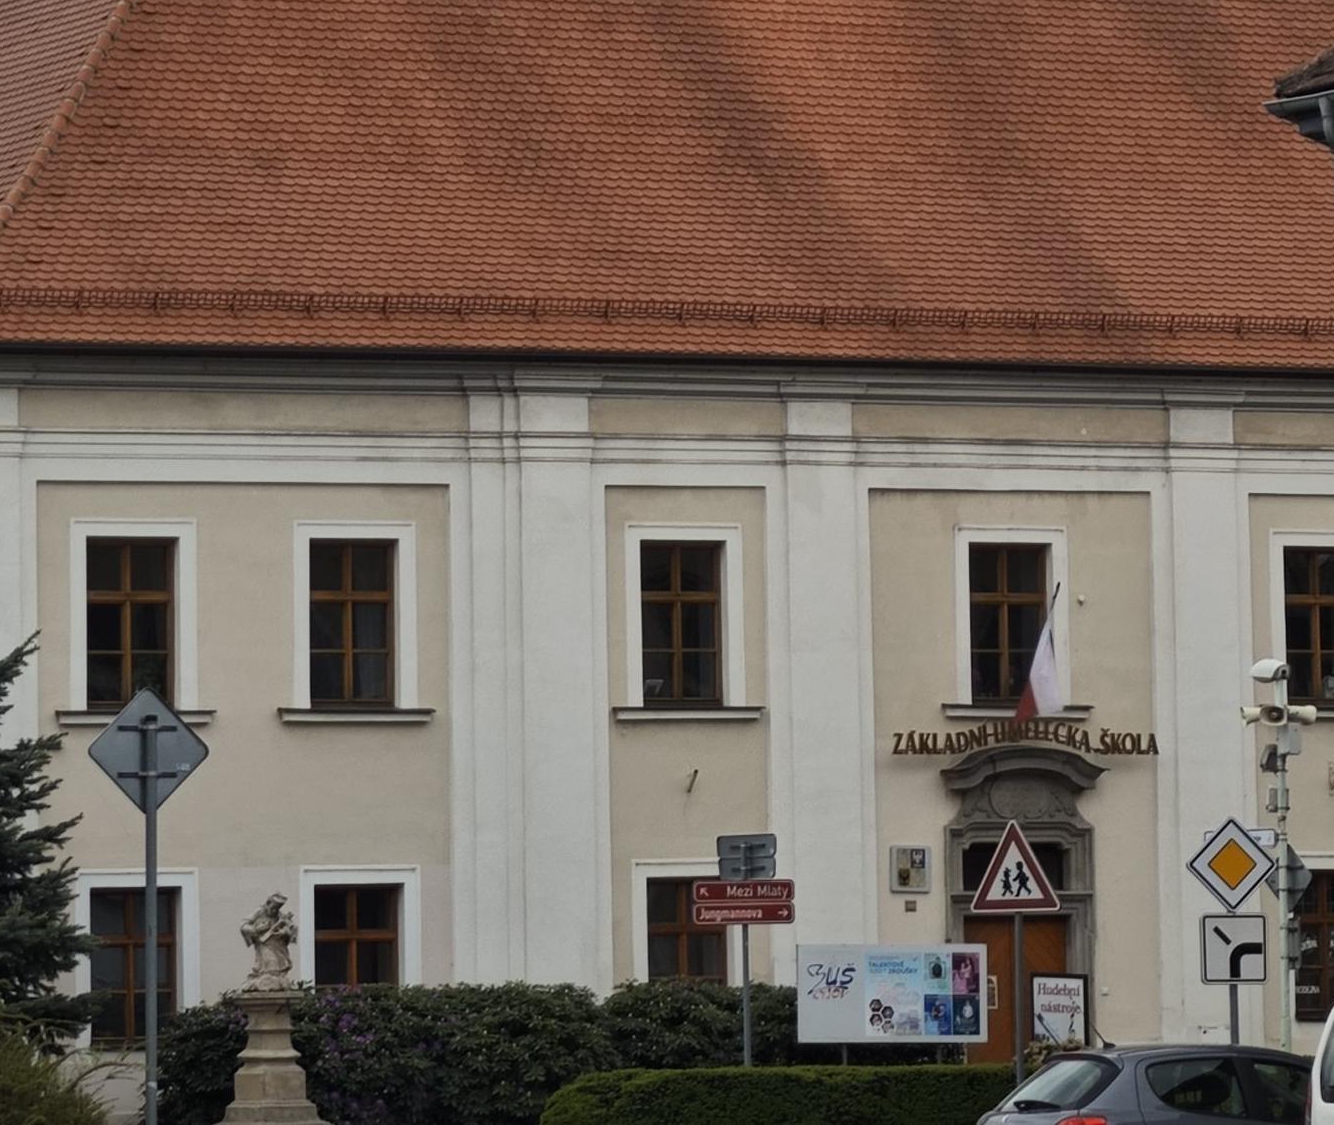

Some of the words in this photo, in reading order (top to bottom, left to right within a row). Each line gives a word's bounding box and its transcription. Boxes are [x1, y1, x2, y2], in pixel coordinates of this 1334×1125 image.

[892, 720, 988, 755] ZÁKLADNÍ
[1099, 727, 1160, 755] ŠKOLA
[727, 885, 753, 898] Mezi
[757, 884, 789, 900] Mlaty
[699, 908, 763, 922] Jungmannova
[1037, 982, 1081, 996] Hudební
